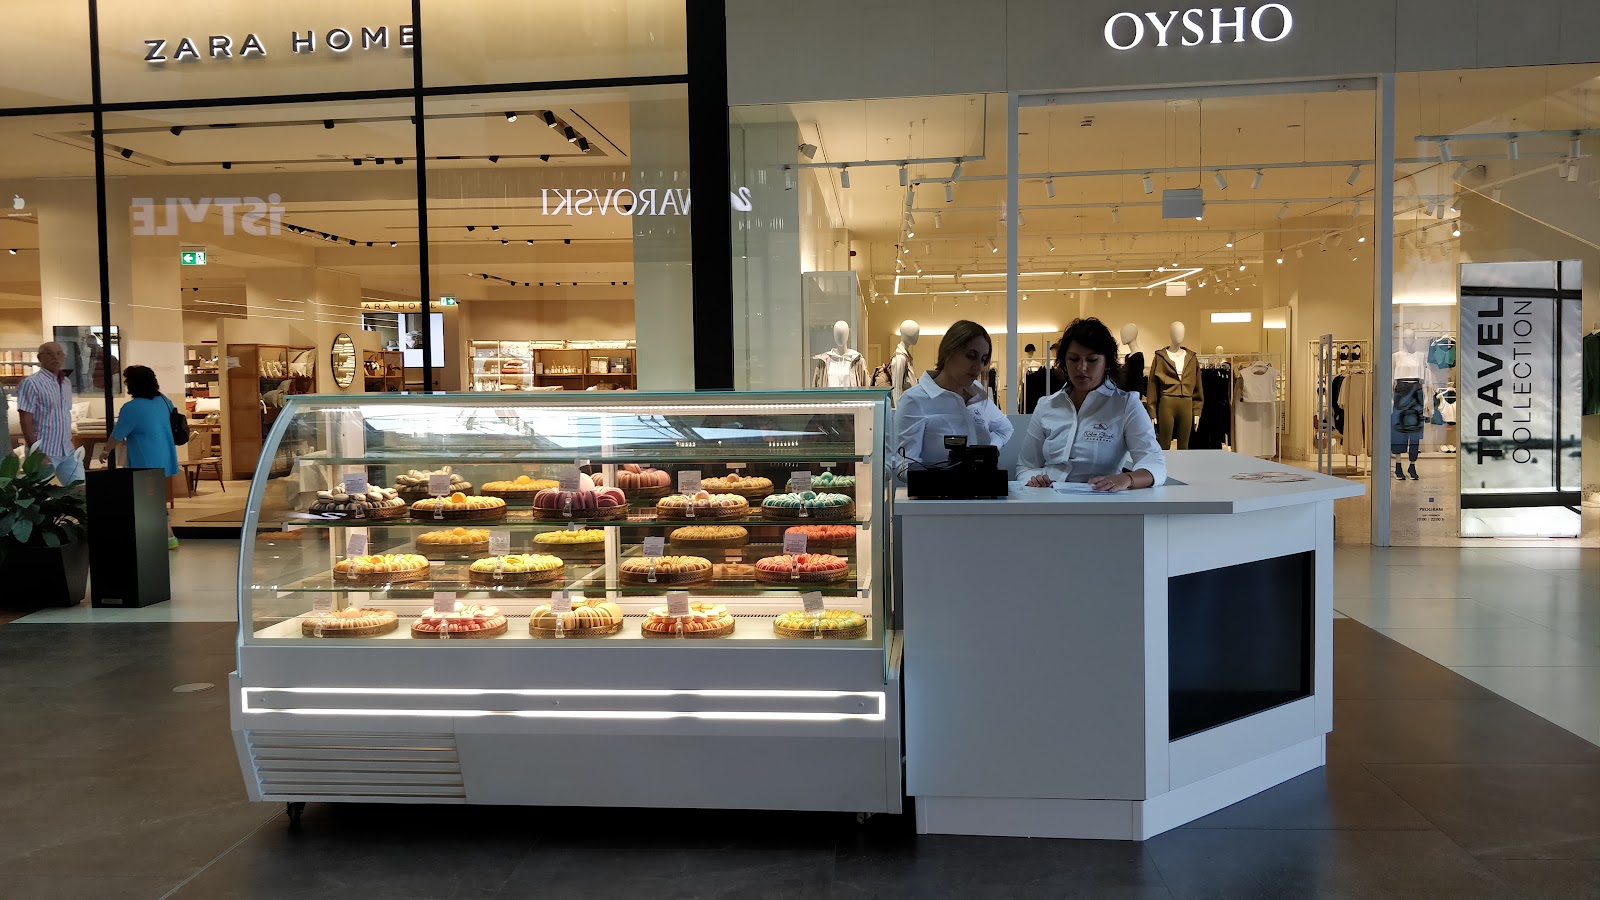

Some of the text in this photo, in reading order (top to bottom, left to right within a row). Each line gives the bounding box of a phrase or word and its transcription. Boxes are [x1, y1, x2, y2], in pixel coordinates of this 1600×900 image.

[144, 25, 413, 62] ZARA HOME
[1104, 3, 1293, 50] OYSHO
[364, 302, 436, 310] ARA HOE
[1477, 297, 1504, 465] TRAVEL
[1512, 300, 1533, 464] COLLECTION
